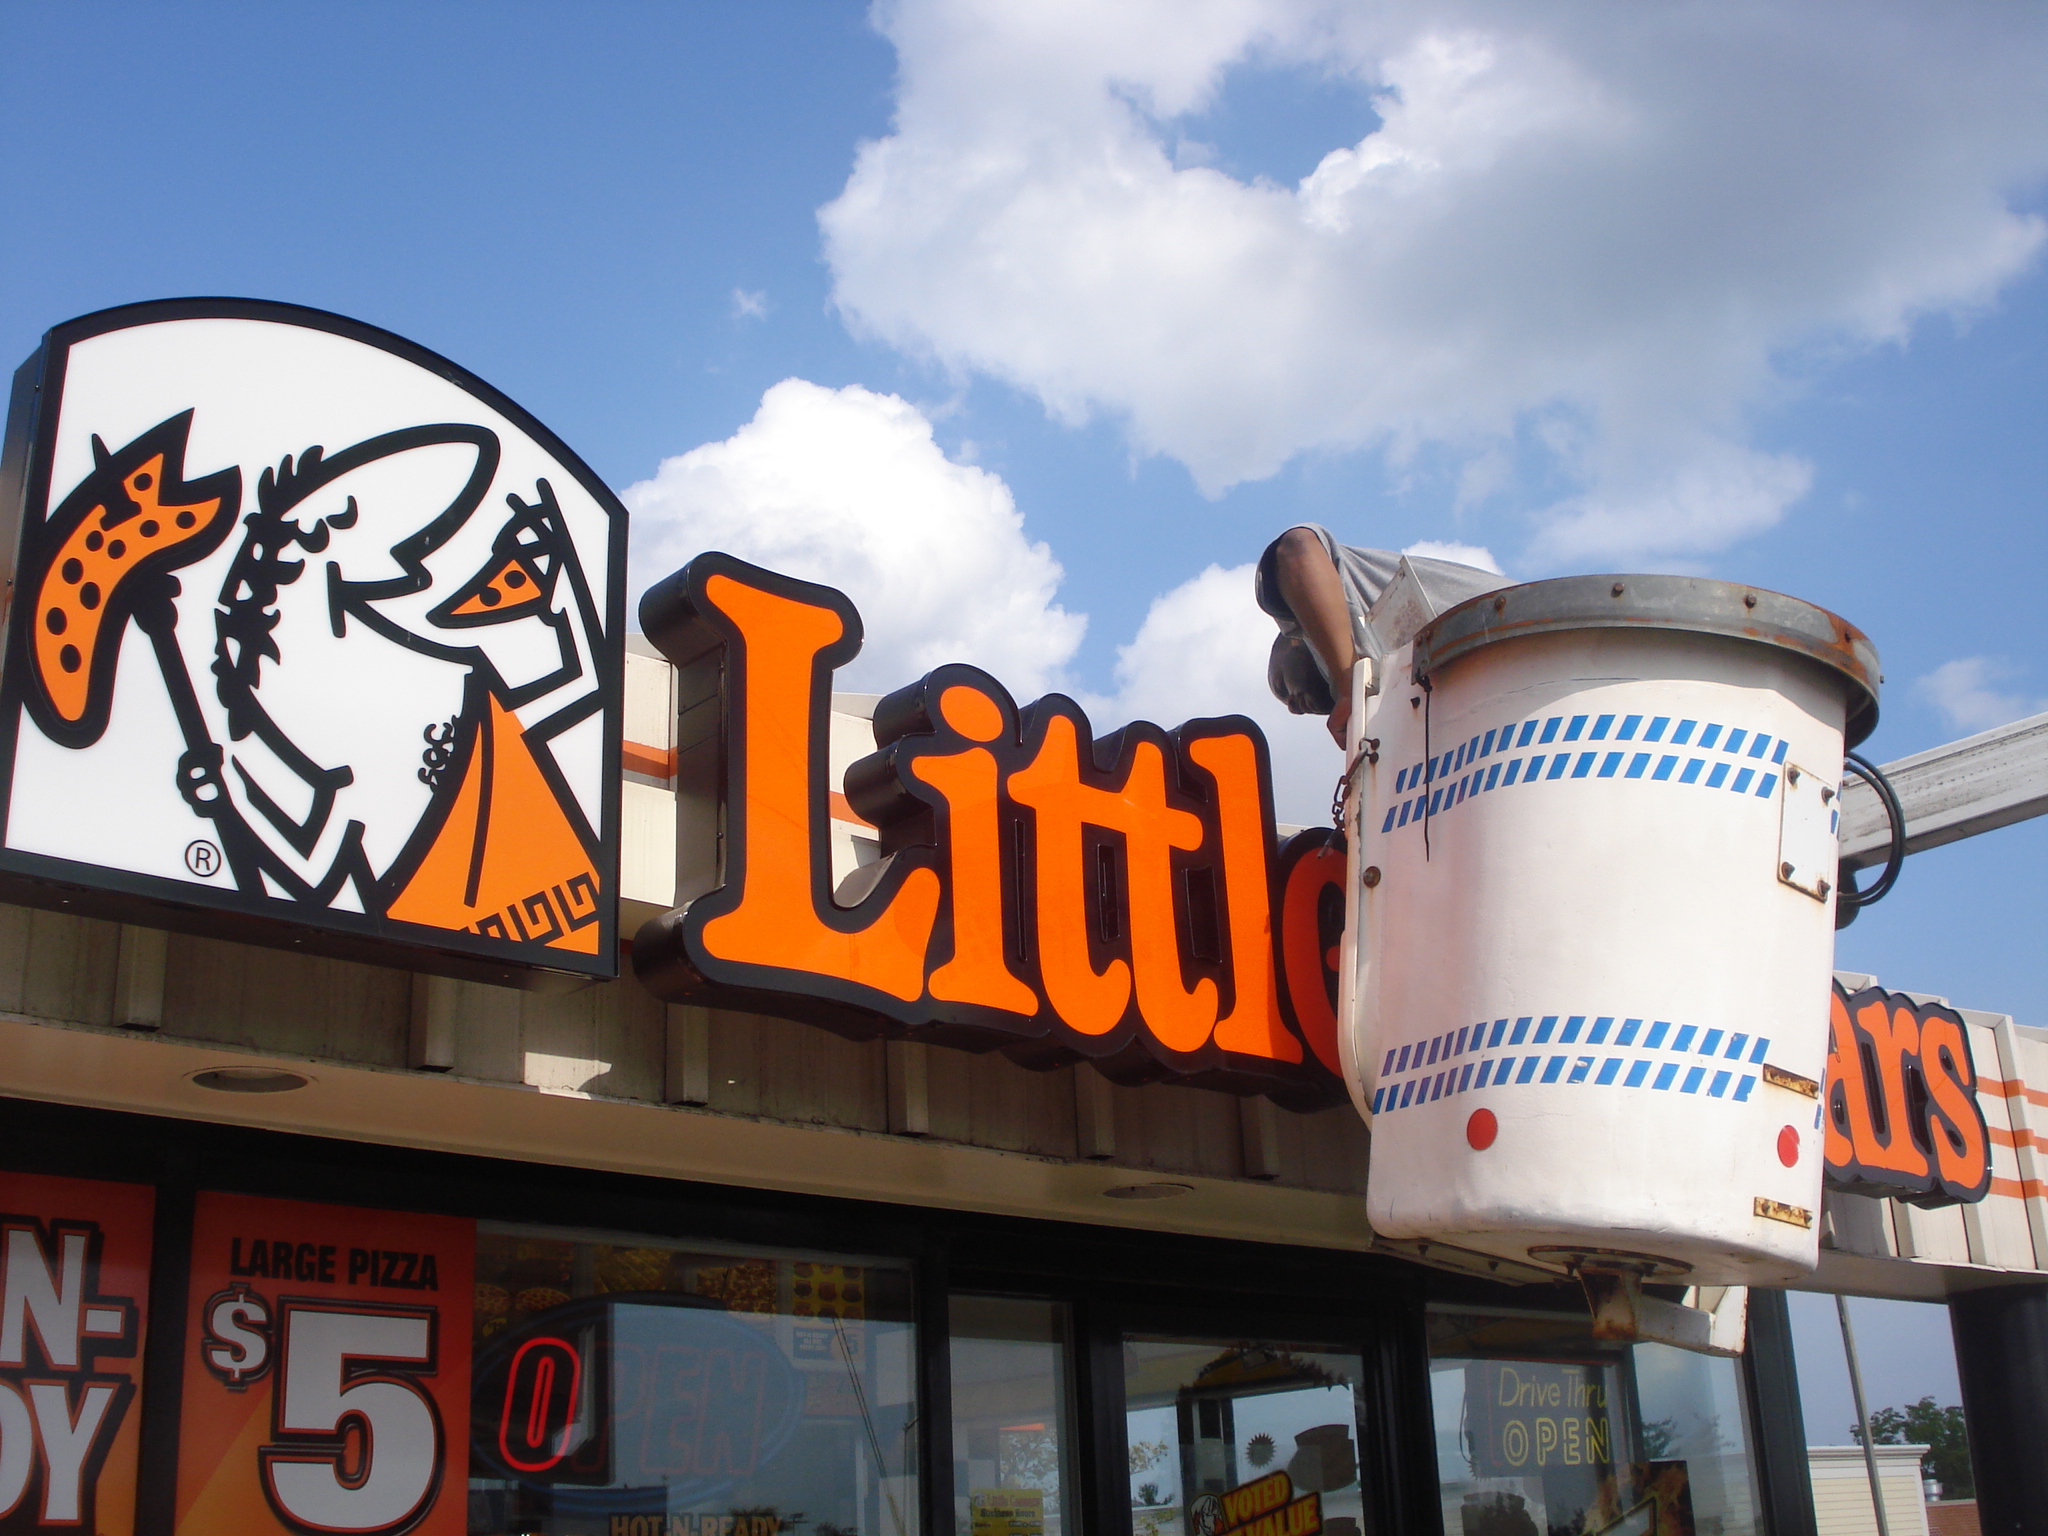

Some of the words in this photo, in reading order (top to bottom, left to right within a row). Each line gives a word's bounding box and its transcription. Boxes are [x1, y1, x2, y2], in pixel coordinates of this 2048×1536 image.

[702, 574, 1347, 1079] Little
[230, 1237, 336, 1284] LARGE
[347, 1248, 439, 1291] PIZZA
[207, 1284, 442, 1534] $5
[1498, 1367, 1561, 1408] Drive
[1562, 1368, 1608, 1409] Thru
[1503, 1417, 1610, 1467] OPEN
[1224, 1474, 1288, 1525] VOTED
